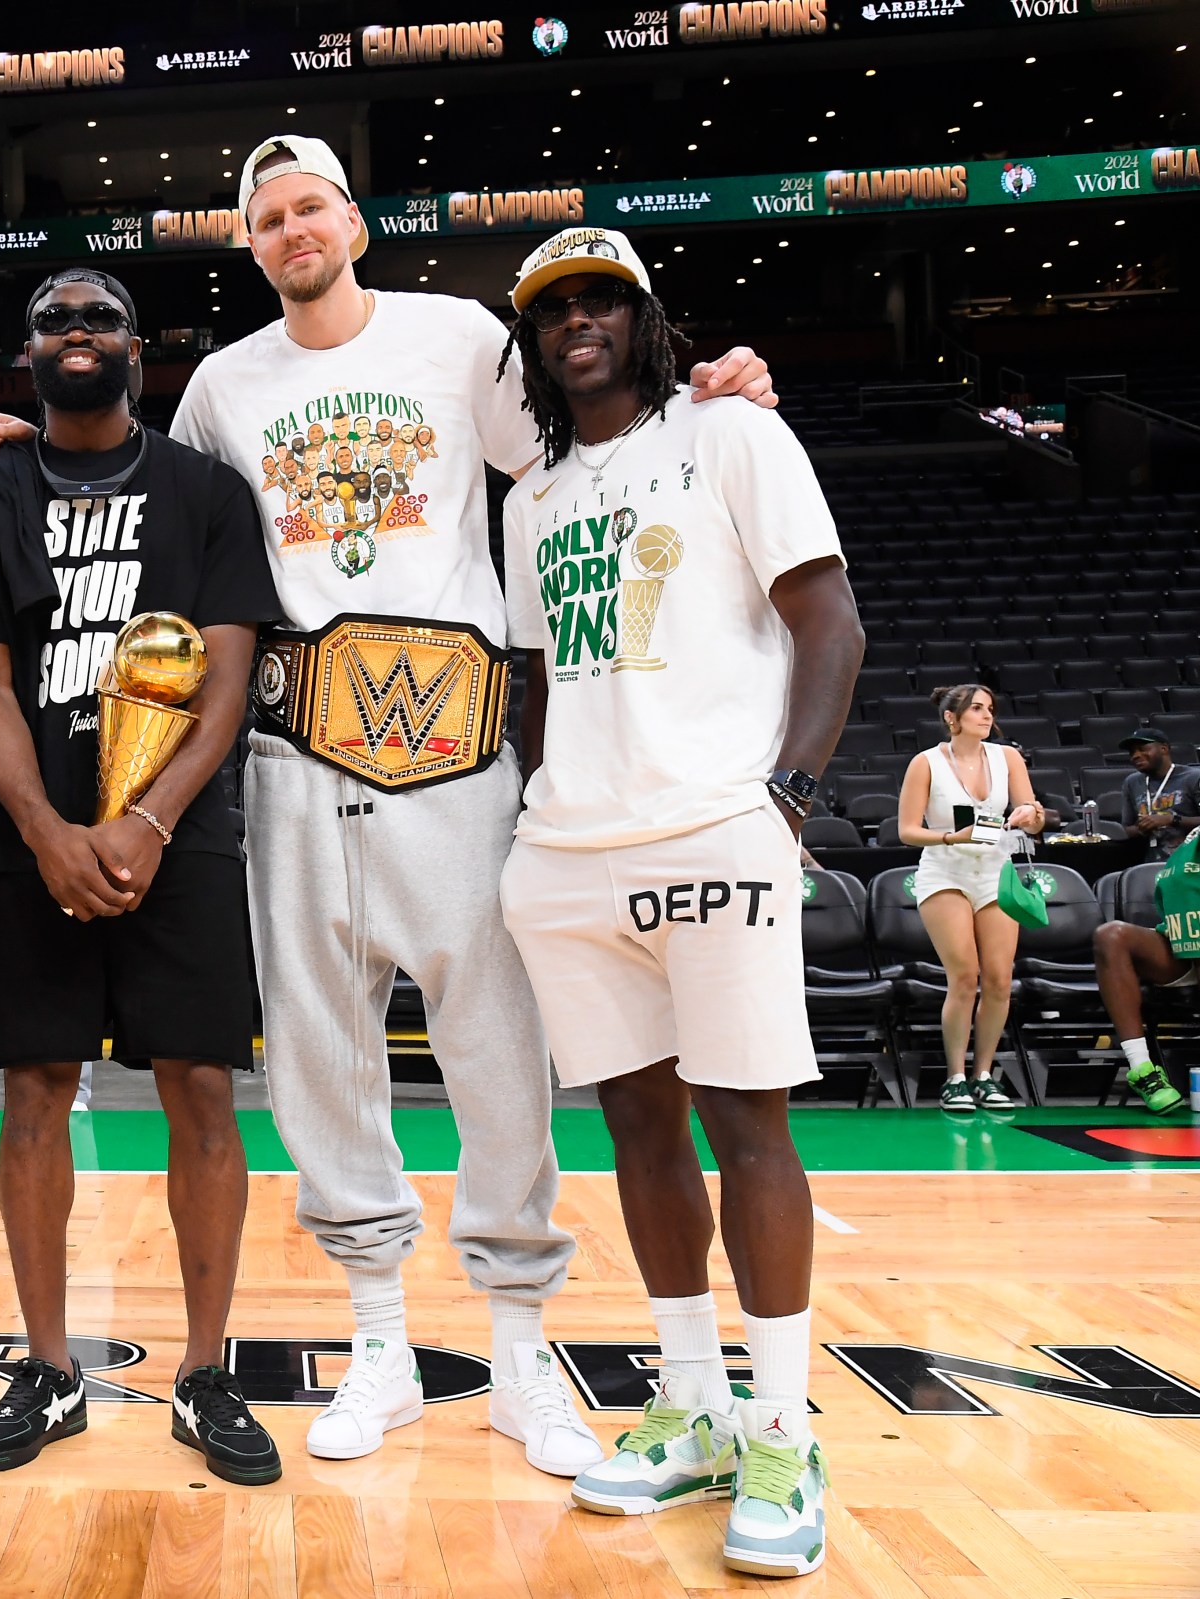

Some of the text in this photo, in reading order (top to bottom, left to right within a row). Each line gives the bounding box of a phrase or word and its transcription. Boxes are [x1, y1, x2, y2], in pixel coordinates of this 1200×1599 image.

[635, 10, 668, 26] 2024
[878, 0, 963, 15] ARBELLA
[888, 6, 954, 20] INSURANCE
[1012, 0, 1078, 18] World
[679, 0, 827, 44] CHAMPIONS
[319, 33, 351, 47] 2024
[362, 20, 503, 65] CHAMPIONS
[605, 26, 668, 49] World
[172, 49, 247, 65] ARBELLA
[179, 59, 240, 69] INSURANCE
[291, 46, 351, 71] World
[1104, 155, 1139, 170] 2024
[780, 178, 813, 192] 2024
[824, 165, 968, 207] CHAMPIONS
[1075, 169, 1140, 193] World
[406, 199, 438, 213] 2024
[448, 188, 584, 227] CHAMPIONS
[631, 193, 707, 207] ARBELLA
[640, 201, 701, 212] INSURANCE
[752, 191, 814, 214] World
[112, 217, 142, 231] 2024
[153, 208, 244, 249] CHAMPI
[379, 212, 438, 234] World
[86, 230, 142, 253] World
[262, 392, 424, 452] NBA CHAMPIONS
[44, 493, 148, 558] STATE
[362, 533, 376, 561] CELTICS
[536, 513, 611, 575] ONLY
[332, 542, 343, 570] BOSTON
[540, 546, 623, 613] WORK
[51, 560, 142, 630] YOUR
[38, 632, 119, 708] SOUR
[332, 748, 453, 781] UNDISPUTED CHAMPION
[629, 881, 774, 932] DEPT.
